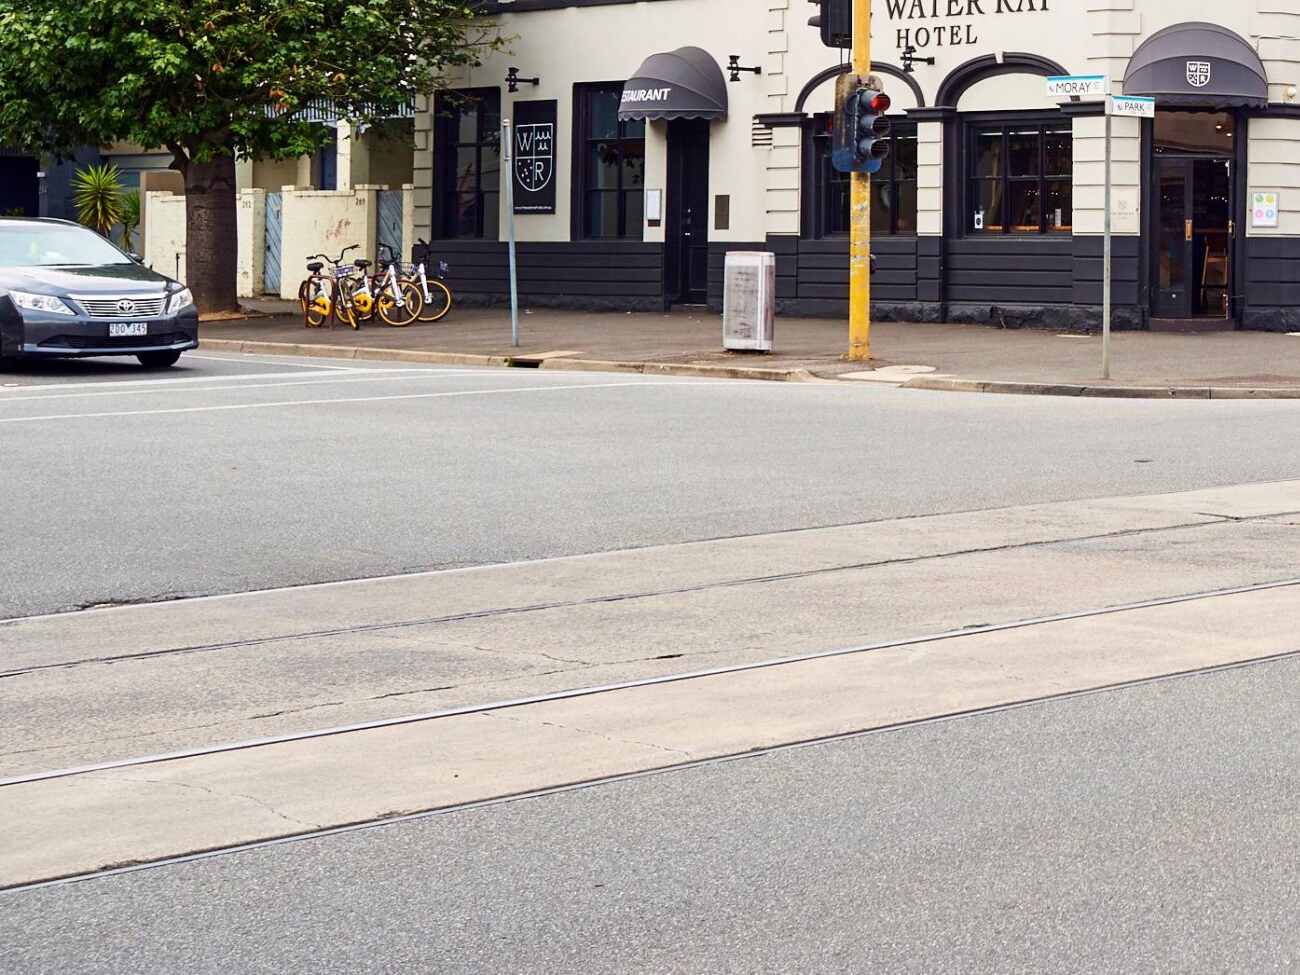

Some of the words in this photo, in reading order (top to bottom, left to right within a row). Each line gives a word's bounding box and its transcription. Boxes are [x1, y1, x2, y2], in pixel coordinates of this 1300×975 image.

[896, 25, 978, 48] HOTEL
[1055, 82, 1092, 93] MORAY
[1124, 102, 1145, 112] PARK
[131, 324, 146, 333] 345
